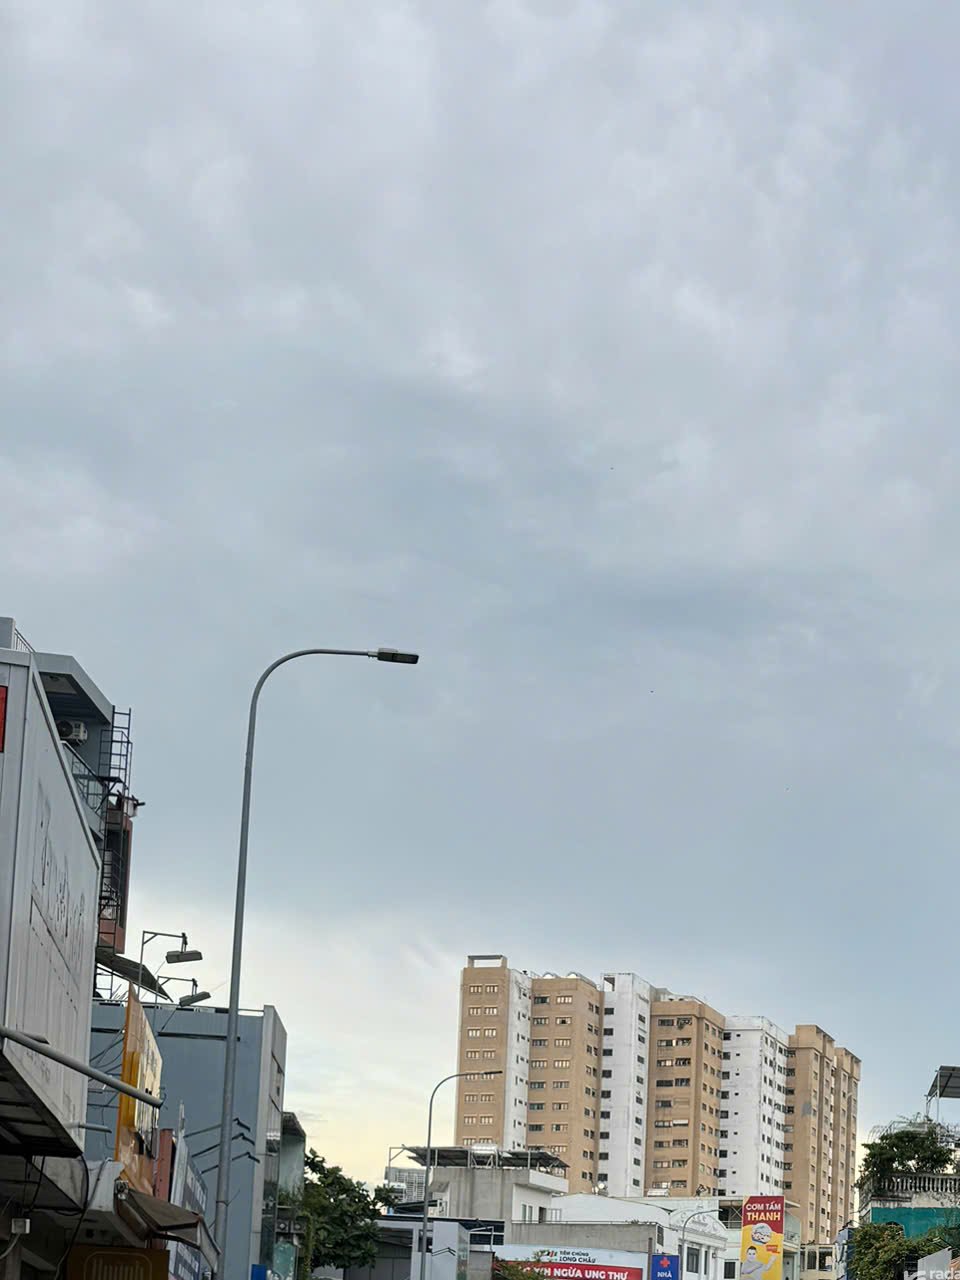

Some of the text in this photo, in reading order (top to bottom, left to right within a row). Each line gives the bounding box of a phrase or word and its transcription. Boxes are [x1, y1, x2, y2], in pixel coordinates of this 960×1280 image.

[745, 1200, 781, 1211] CƠM TẤM
[746, 1212, 781, 1221] THANH
[554, 1266, 583, 1279] NGỪA
[585, 1269, 606, 1280] UNG
[607, 1271, 629, 1280] THƯ
[657, 1270, 673, 1278] NHÀ
